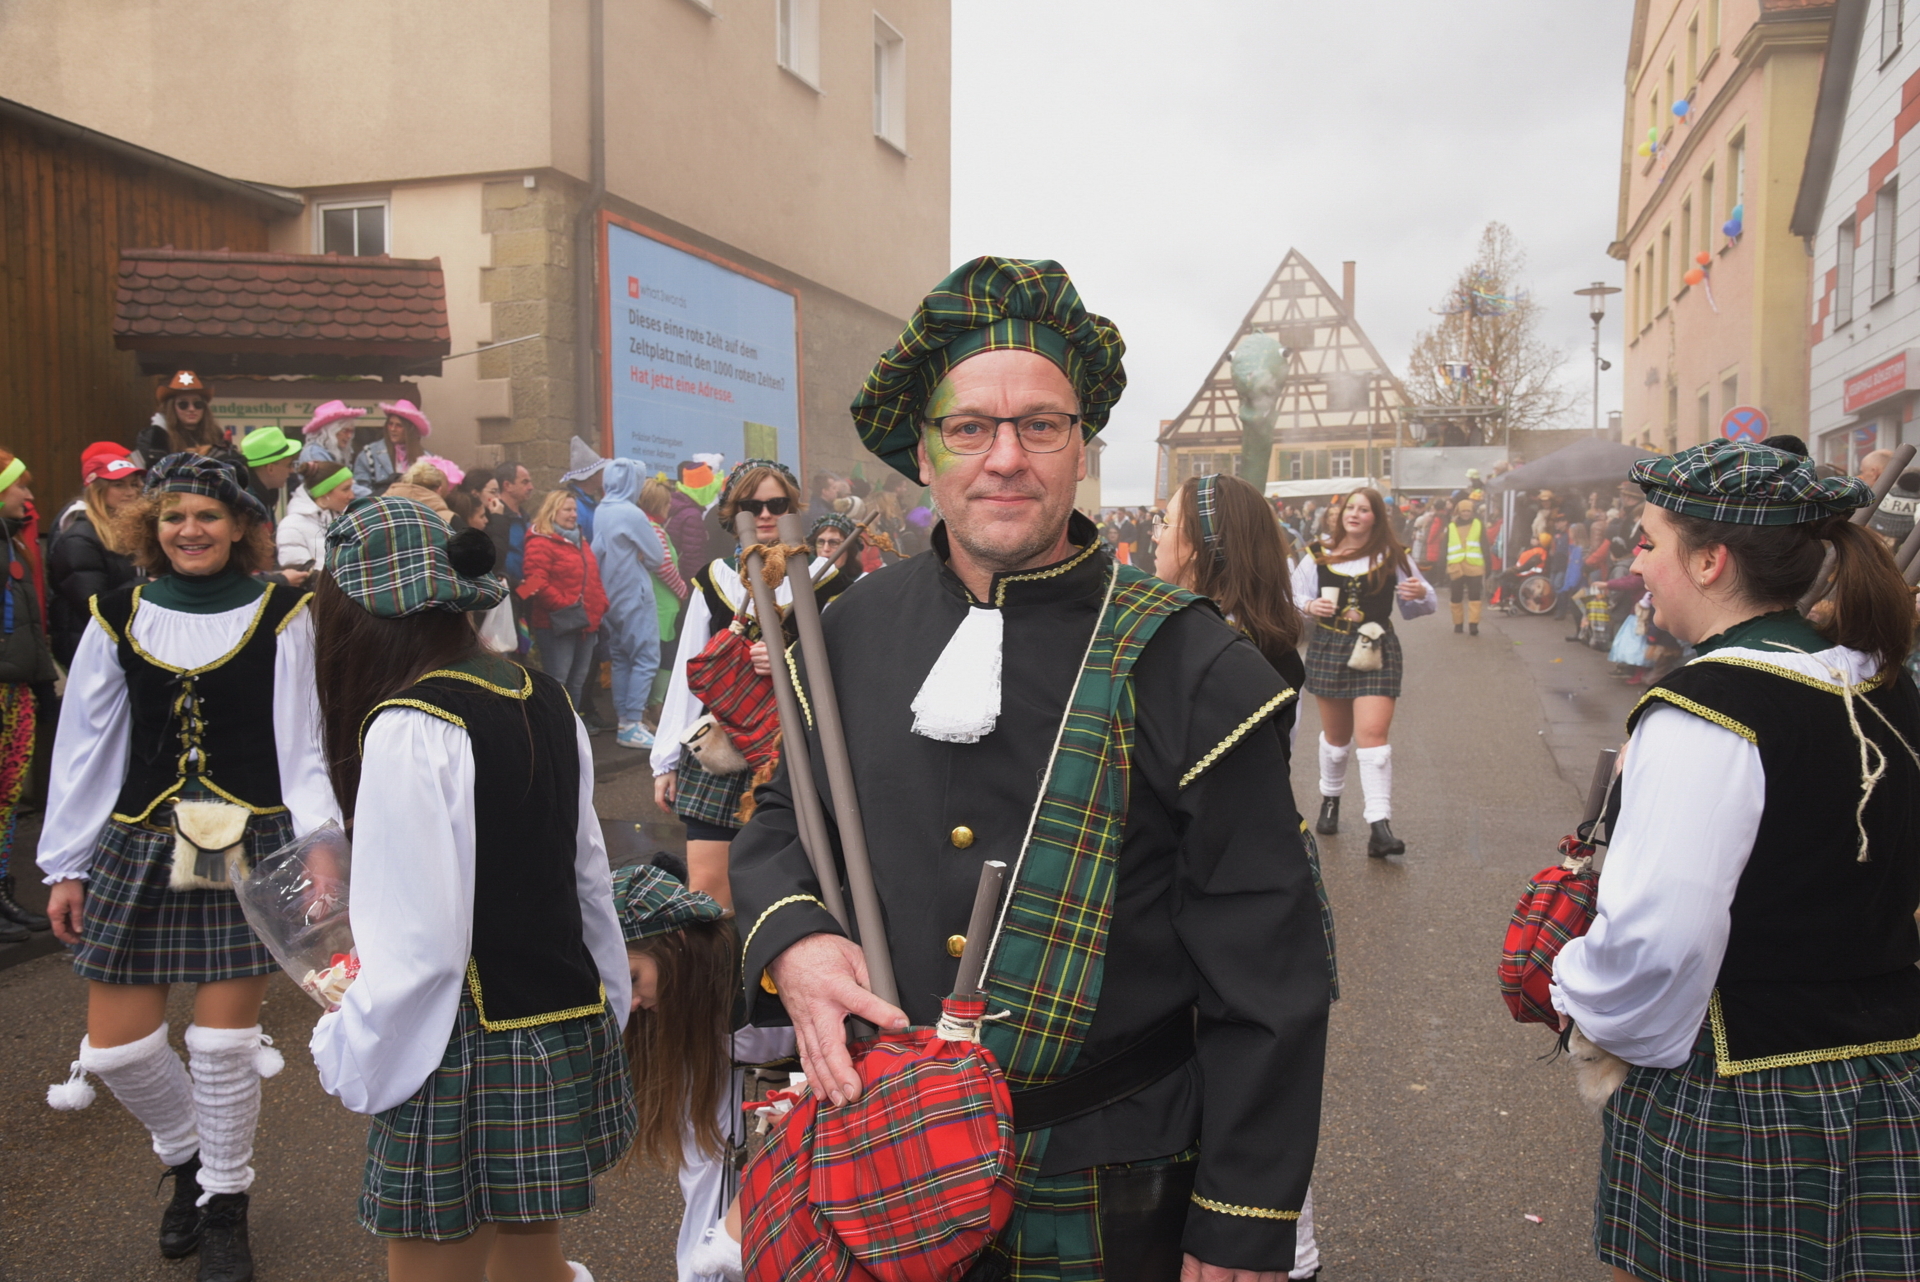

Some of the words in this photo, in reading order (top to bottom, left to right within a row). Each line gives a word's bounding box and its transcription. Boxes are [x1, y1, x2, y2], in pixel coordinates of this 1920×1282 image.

[628, 308, 662, 333] Dieses
[663, 318, 684, 339] eine
[686, 328, 705, 344] rote
[706, 331, 724, 350] Zelt
[725, 339, 739, 354] auf
[740, 341, 758, 360] dem
[629, 336, 675, 362] Zeltplatz
[676, 349, 693, 368] mit
[694, 353, 712, 373] den
[713, 359, 733, 378] 1000
[735, 367, 757, 384] roten
[758, 371, 785, 392] Zelten?
[630, 365, 649, 385] Hat
[650, 368, 675, 391] jetzt
[676, 375, 696, 395] eine
[698, 381, 735, 403] Adresse.
[210, 402, 288, 417] andgasthof
